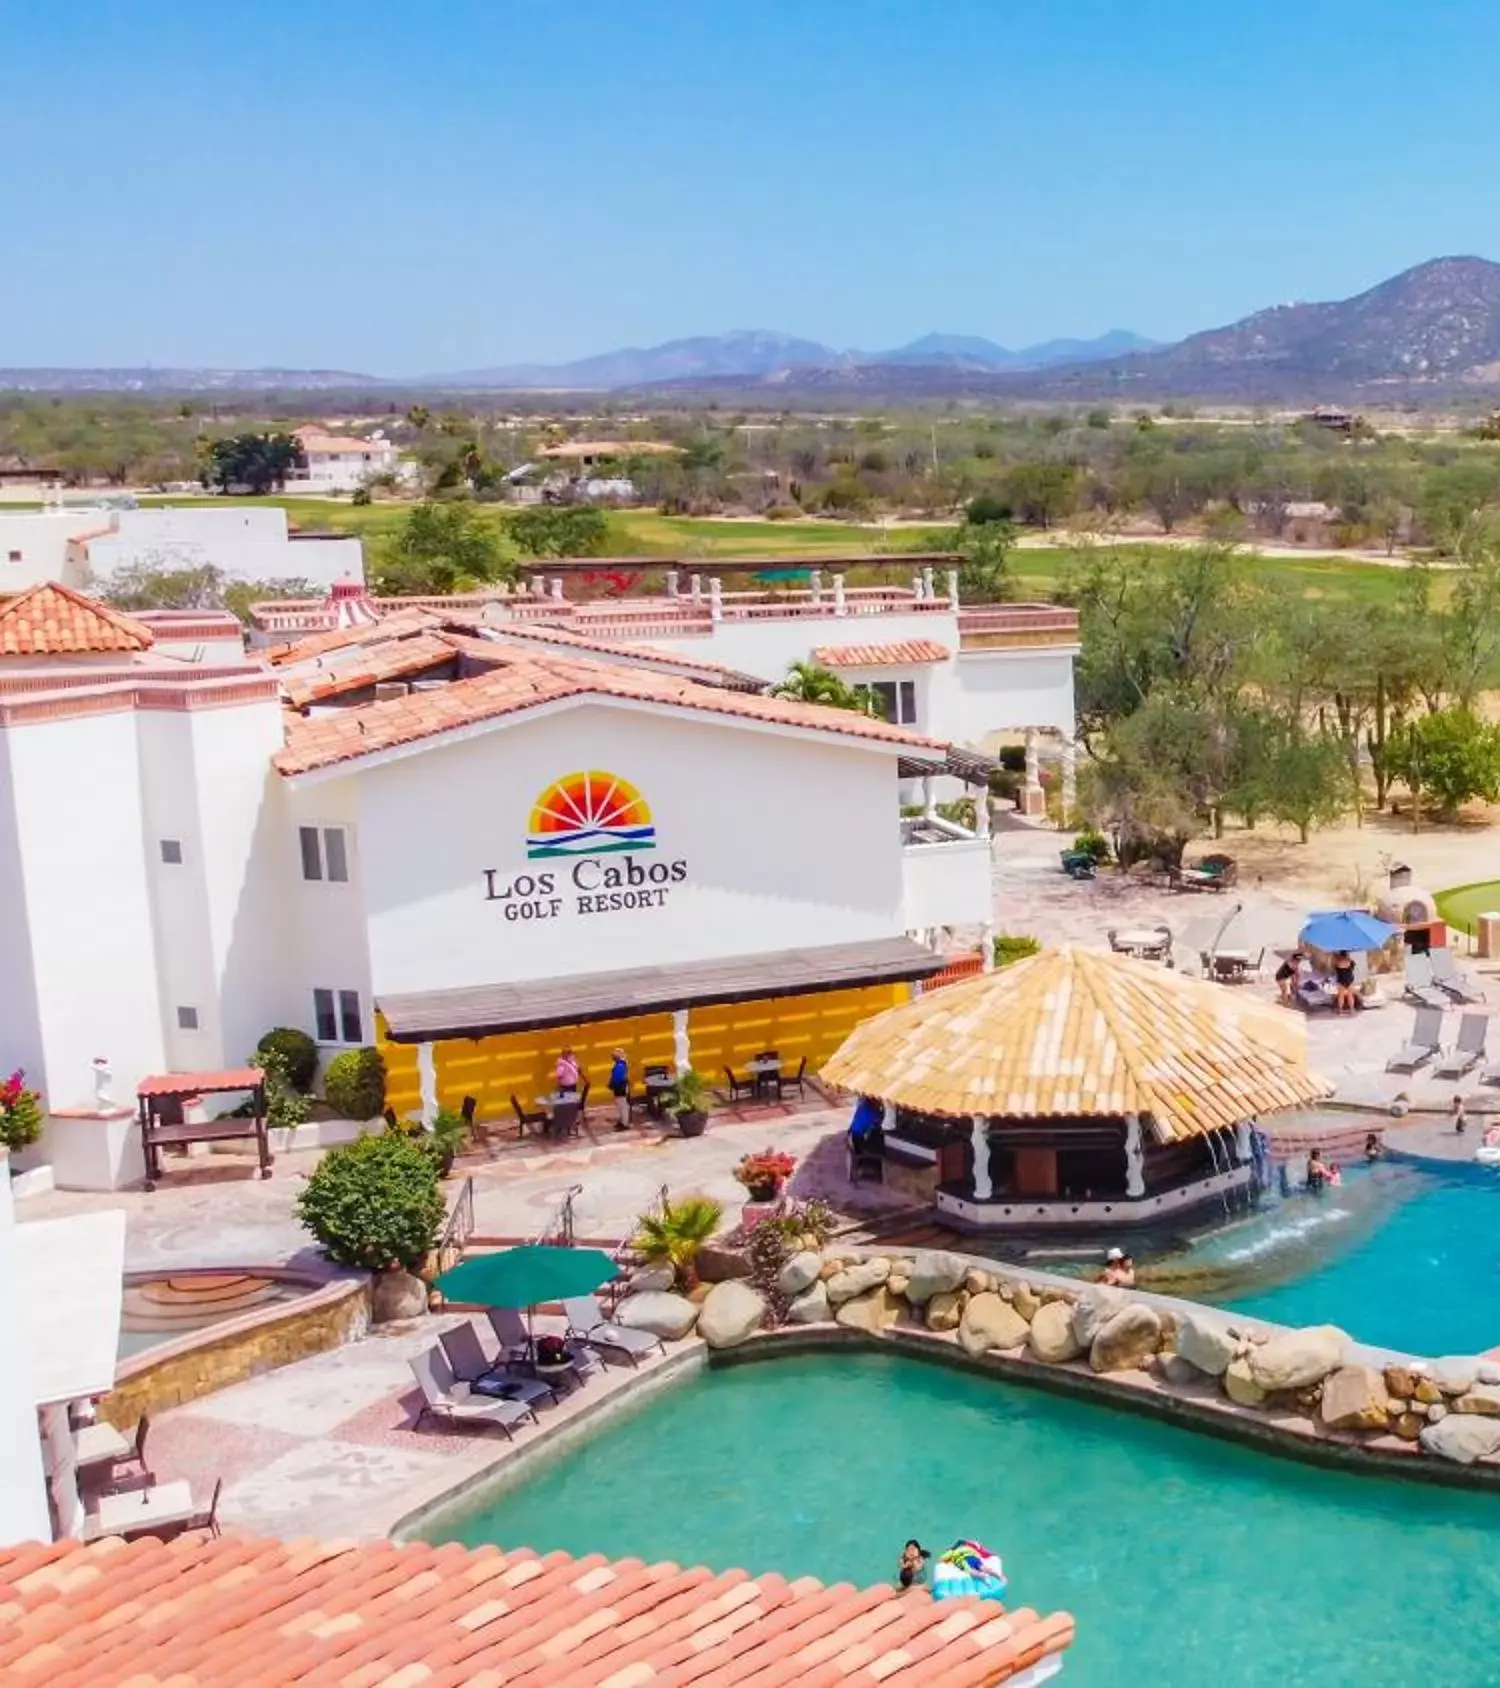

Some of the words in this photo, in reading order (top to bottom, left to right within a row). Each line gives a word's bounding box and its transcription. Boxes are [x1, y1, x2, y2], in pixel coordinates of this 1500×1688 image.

[482, 868, 555, 901] Los
[572, 855, 688, 891] Cabos
[504, 898, 563, 921] GOLF
[577, 887, 670, 915] RESORT
